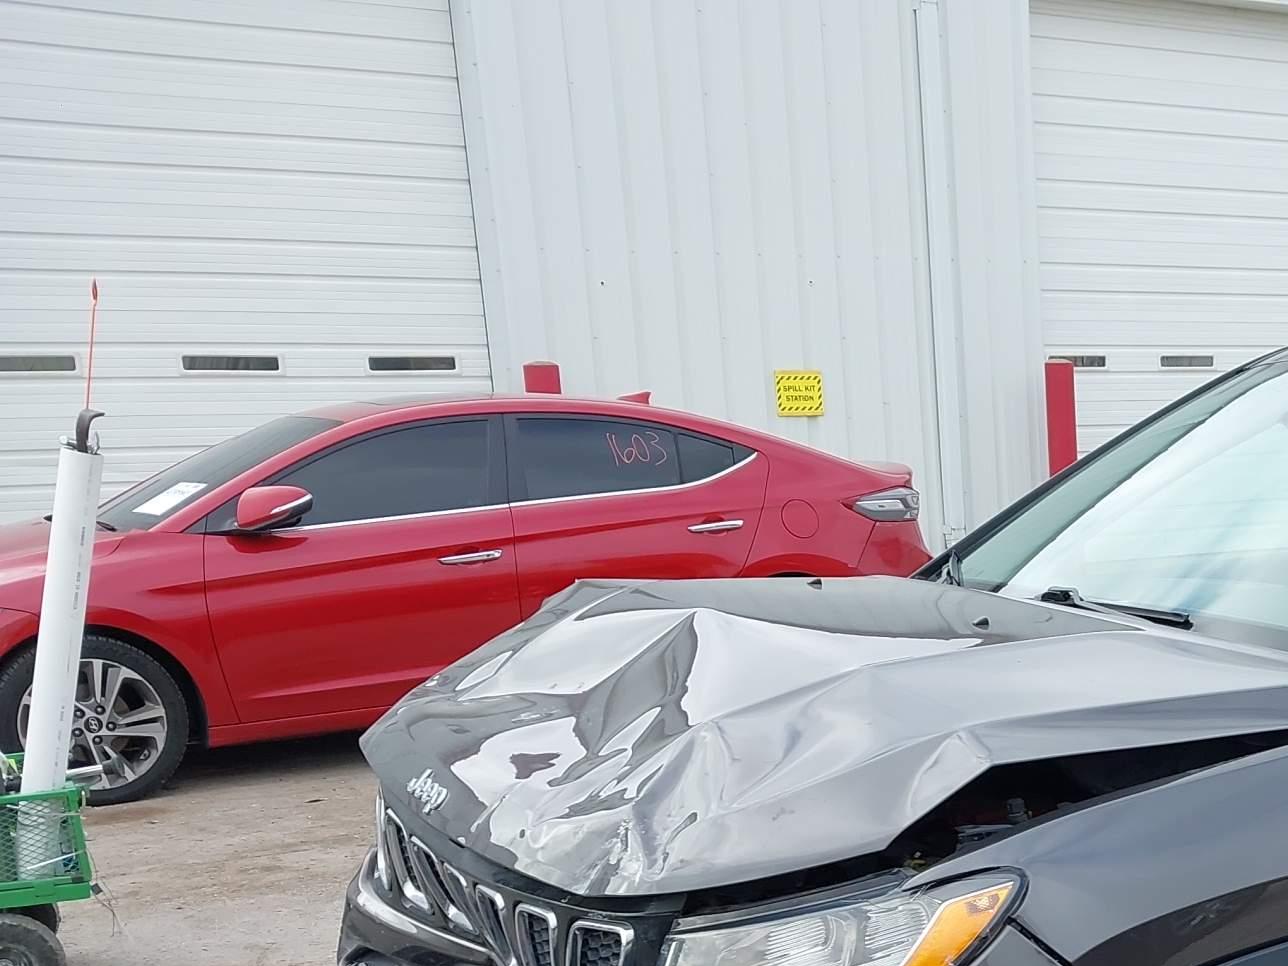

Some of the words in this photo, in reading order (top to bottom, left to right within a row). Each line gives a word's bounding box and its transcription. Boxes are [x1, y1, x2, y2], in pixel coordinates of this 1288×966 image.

[783, 384, 803, 393] SPILL
[804, 385, 816, 393] KIT
[606, 431, 667, 468] 1603
[406, 767, 449, 816] Jeep
